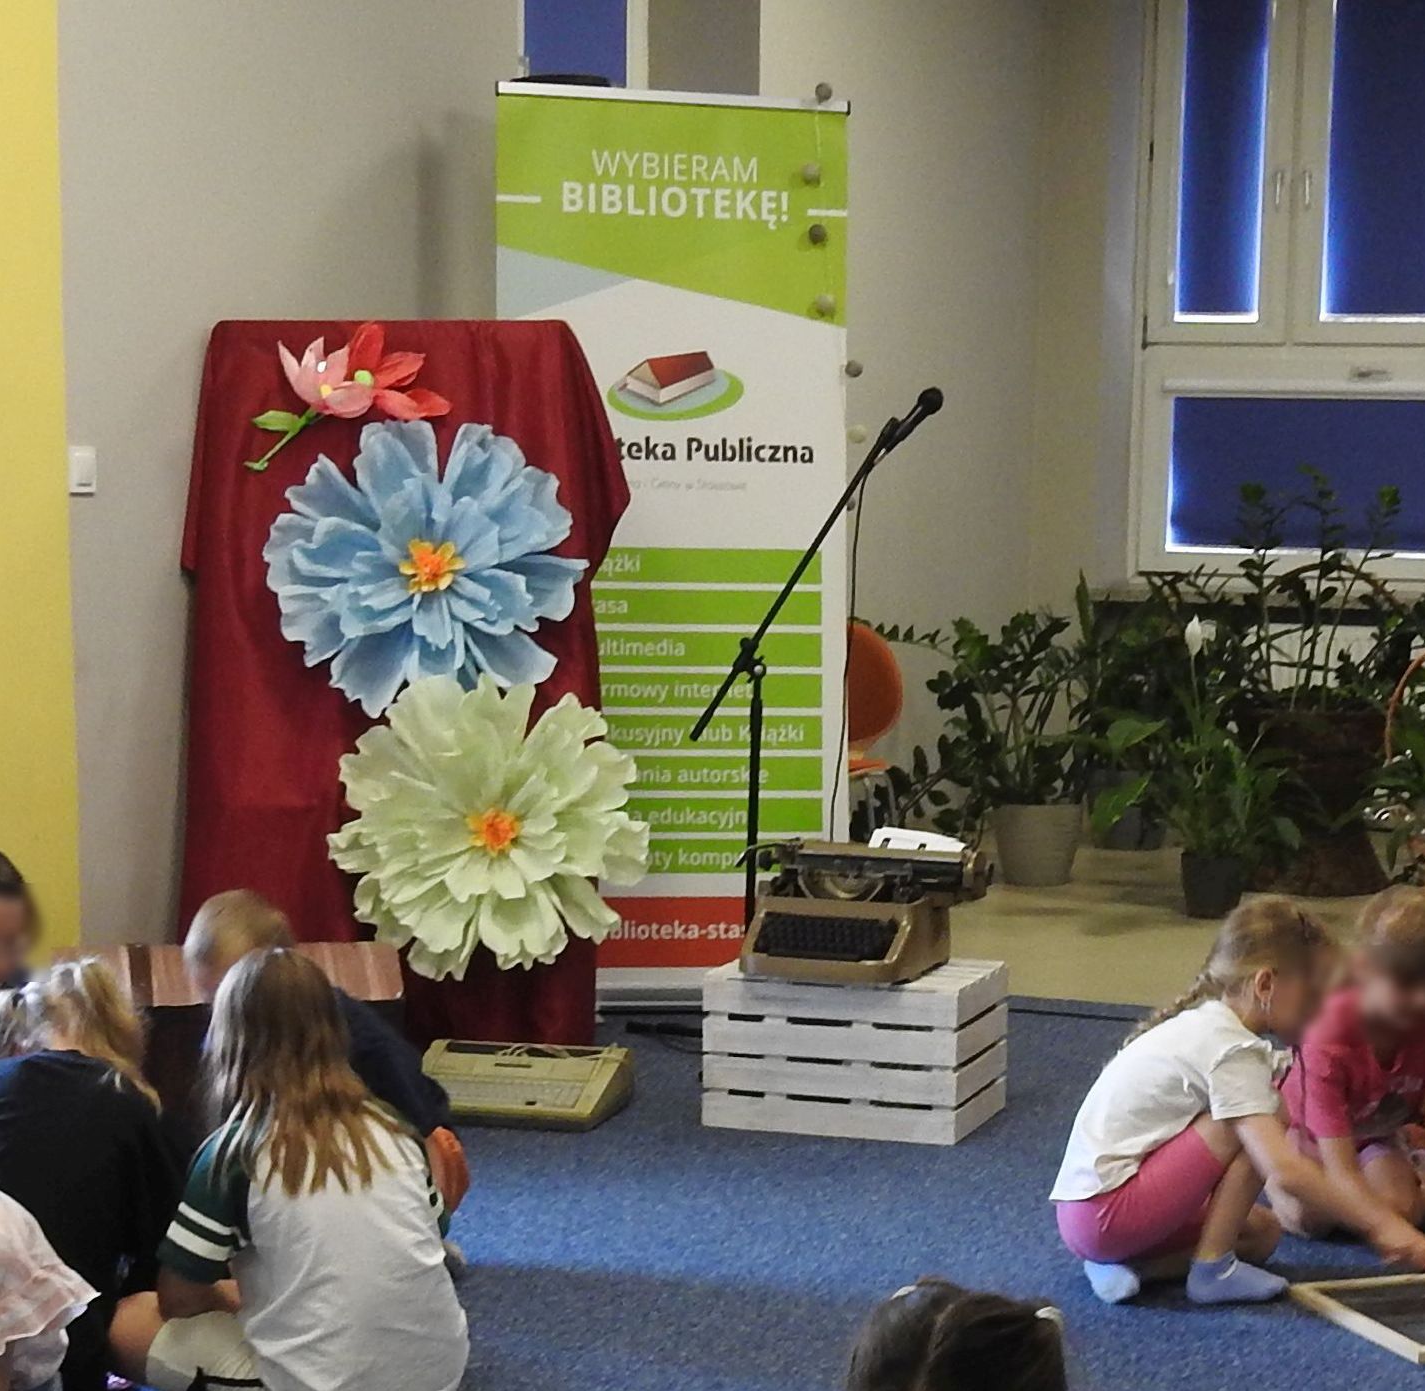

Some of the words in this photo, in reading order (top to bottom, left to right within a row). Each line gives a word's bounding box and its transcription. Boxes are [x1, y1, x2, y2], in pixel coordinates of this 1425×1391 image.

[591, 149, 758, 183] WYBIERAM
[562, 181, 789, 230] BIBLIOTEKĘ!
[615, 436, 676, 461] teka
[686, 436, 814, 464] Publiczna
[599, 554, 641, 577] ążki
[594, 599, 628, 614] asa
[601, 683, 669, 703] rmowy
[609, 724, 684, 746] kusyjny
[739, 723, 804, 746] Kiążki
[648, 807, 748, 829] edukacyjn
[678, 847, 738, 870] komp
